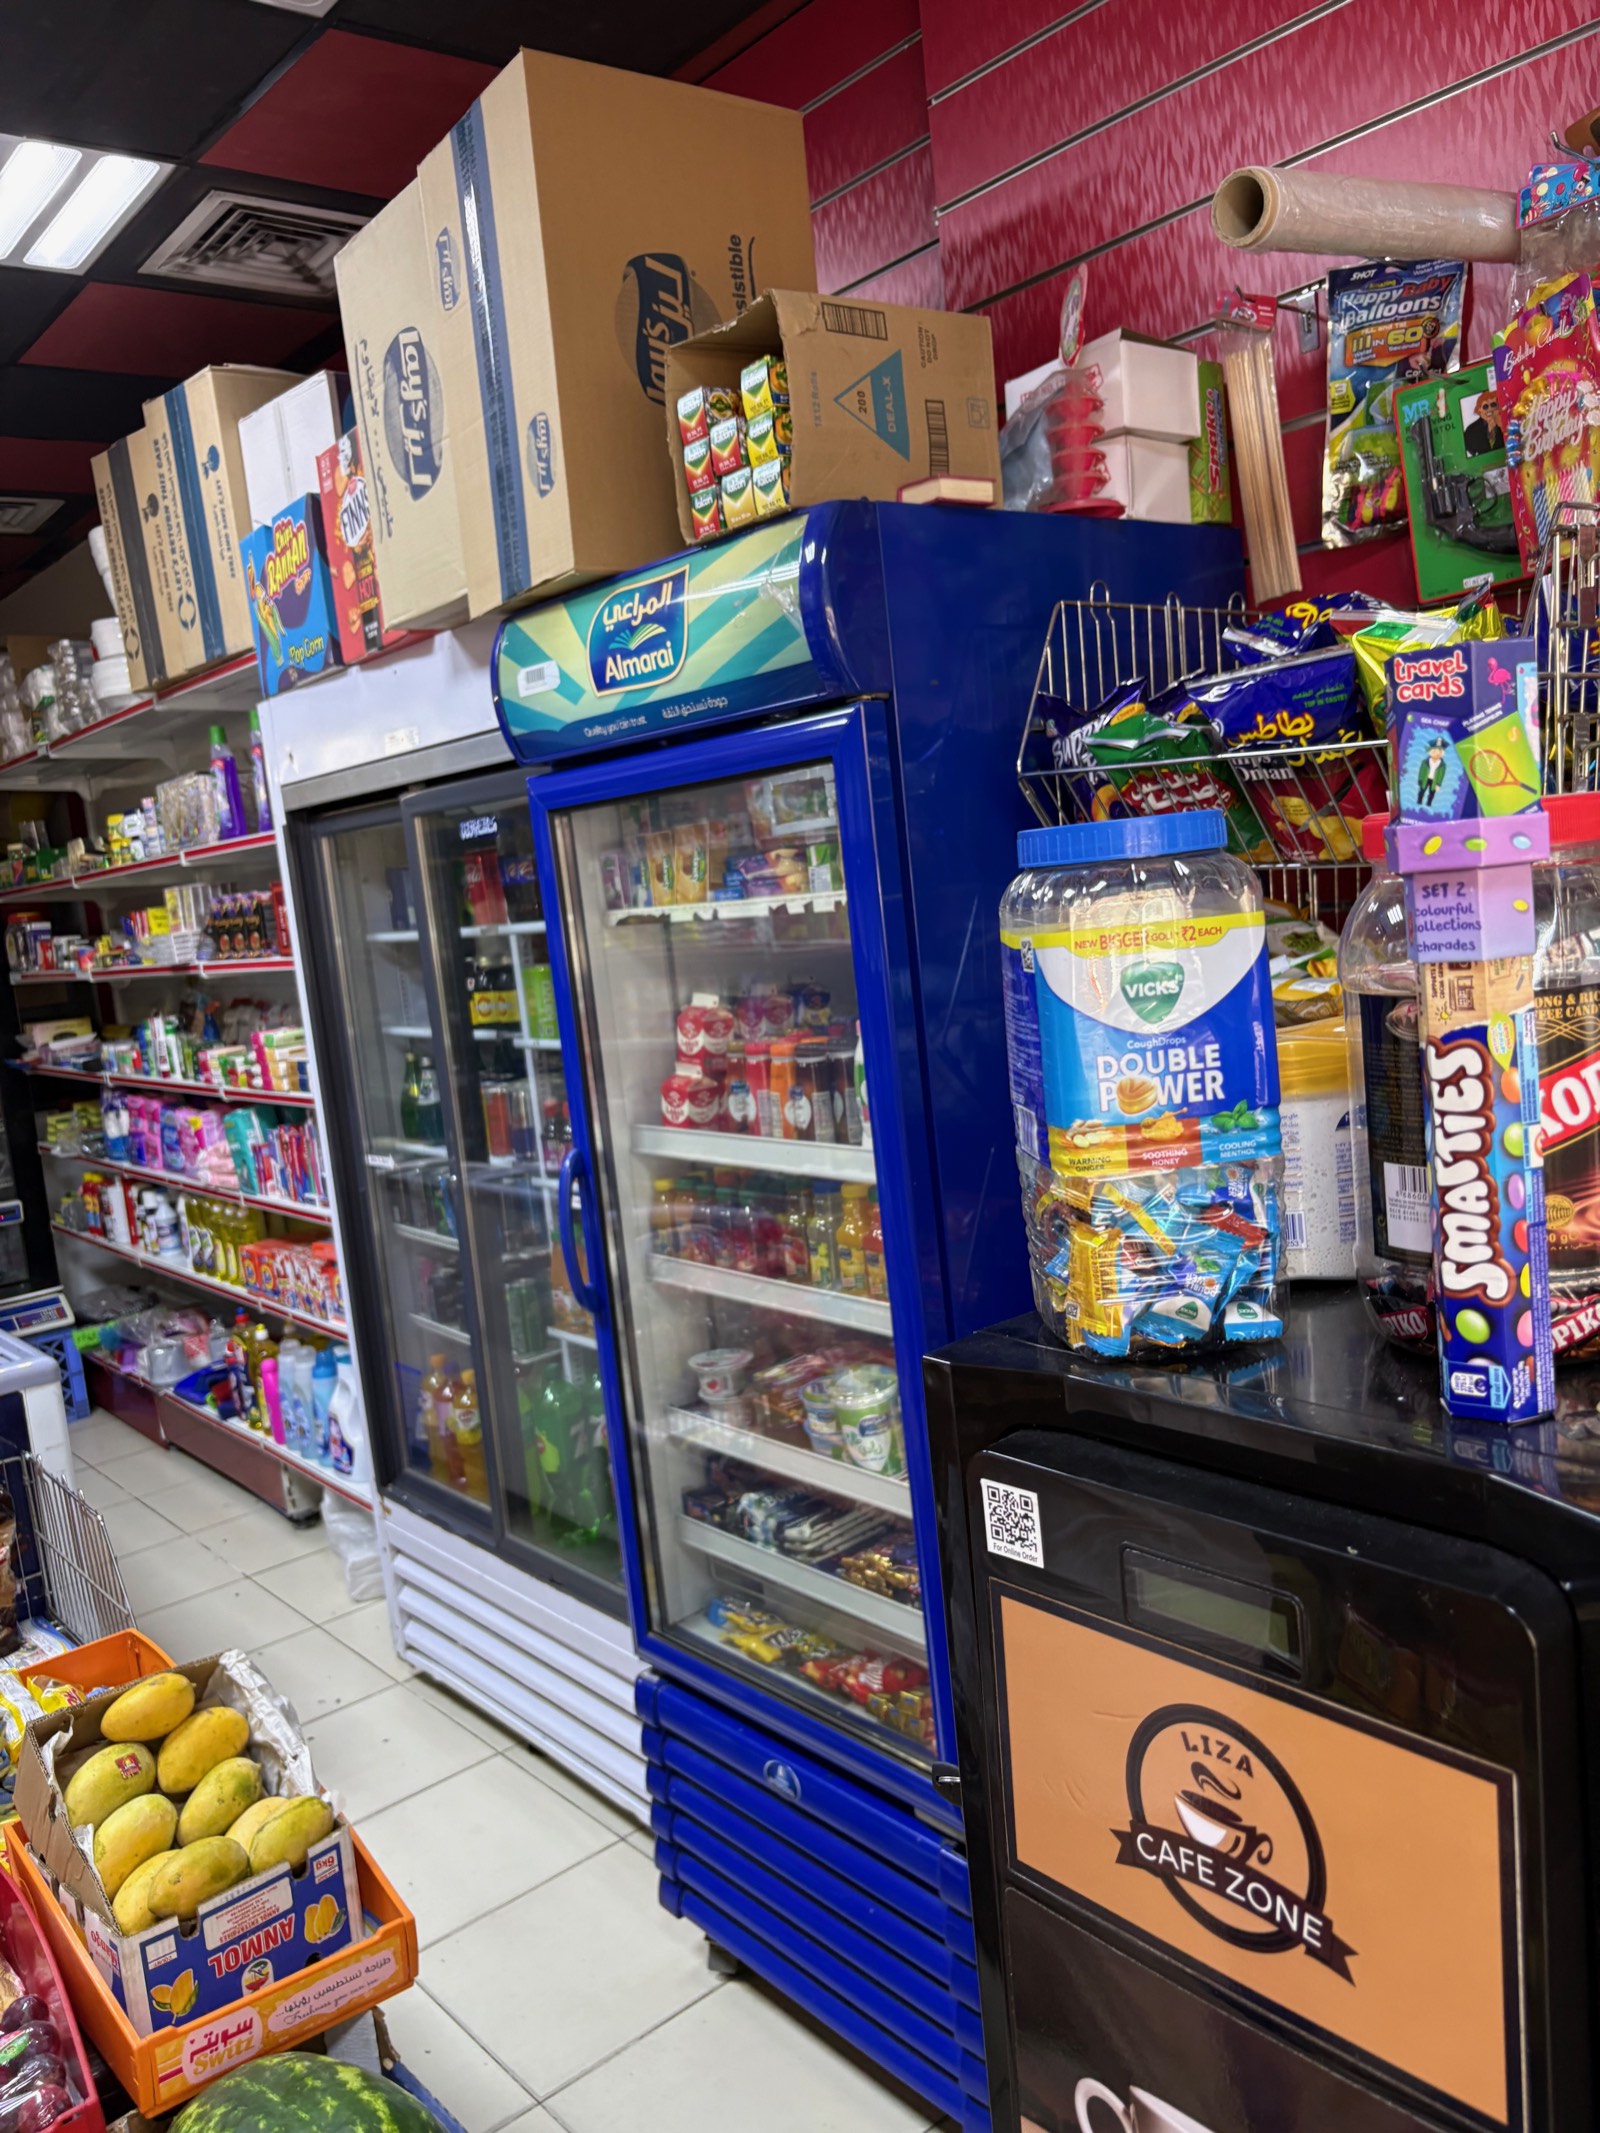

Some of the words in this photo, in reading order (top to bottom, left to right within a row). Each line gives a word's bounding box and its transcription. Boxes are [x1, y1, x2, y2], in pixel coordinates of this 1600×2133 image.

[729, 234, 746, 316] sistible
[1350, 269, 1377, 281] SHOT
[1402, 275, 1454, 297] Baby
[1341, 288, 1403, 309] Happy
[1342, 295, 1441, 328] Balloons
[1372, 338, 1384, 347] IN
[1387, 326, 1423, 345] 60
[1503, 342, 1535, 375] Birthday
[857, 390, 867, 414] 200
[882, 376, 896, 433] DEAL-X
[1520, 390, 1578, 438] Happy
[1523, 407, 1585, 461] Birthday
[153, 438, 165, 470] CASE
[1205, 403, 1221, 494] Snake
[158, 473, 168, 502] THIS
[359, 579, 376, 599] HOT
[602, 581, 673, 632] المراعي
[289, 644, 305, 667] Pop
[305, 635, 324, 656] Corn
[605, 641, 674, 684] Almarai
[1394, 650, 1467, 682] travel
[1397, 675, 1465, 702] cards
[584, 723, 607, 738] Quality
[1227, 710, 1315, 747] بطاطس
[1422, 883, 1448, 898] SET
[1456, 882, 1466, 897] 2
[1415, 902, 1474, 917] colourful
[1075, 939, 1097, 950] NEW
[1100, 931, 1149, 950] BIGGER
[1181, 926, 1197, 941] ₹2
[1198, 926, 1222, 937] EACH
[1417, 939, 1476, 953] charades
[1125, 978, 1180, 998] VICKS
[1535, 995, 1563, 1008] ONG
[1565, 993, 1577, 1006] &
[1565, 1004, 1600, 1019] CAND
[1127, 1036, 1186, 1049] CoughDrops
[1096, 1043, 1221, 1079] DOUBLE
[1539, 1051, 1600, 1140] KO
[1142, 1149, 1188, 1160] SOOTHING
[1218, 1140, 1257, 1151] COOLING
[1220, 1148, 1256, 1158] MENTHOL
[1068, 1156, 1111, 1166] WARMING
[1075, 1164, 1105, 1173] GINGER
[1151, 1158, 1180, 1166] HONEY
[1427, 1045, 1509, 1300] SMARTIES
[993, 1542, 1002, 1551] For
[1004, 1545, 1021, 1558] Online
[1022, 1551, 1038, 1563] Order
[1180, 1731, 1254, 1779] LIZA
[314, 1855, 336, 1872] 6kg
[1137, 1833, 1216, 1886] CAFE
[1225, 1867, 1323, 1948] ZONE
[208, 1914, 295, 1978] ANMOL
[283, 2001, 332, 2026] Freshness
[331, 1991, 350, 2008] you
[350, 1984, 365, 1997] can
[189, 2016, 254, 2063] سويتز
[193, 2035, 256, 2076] Switz
